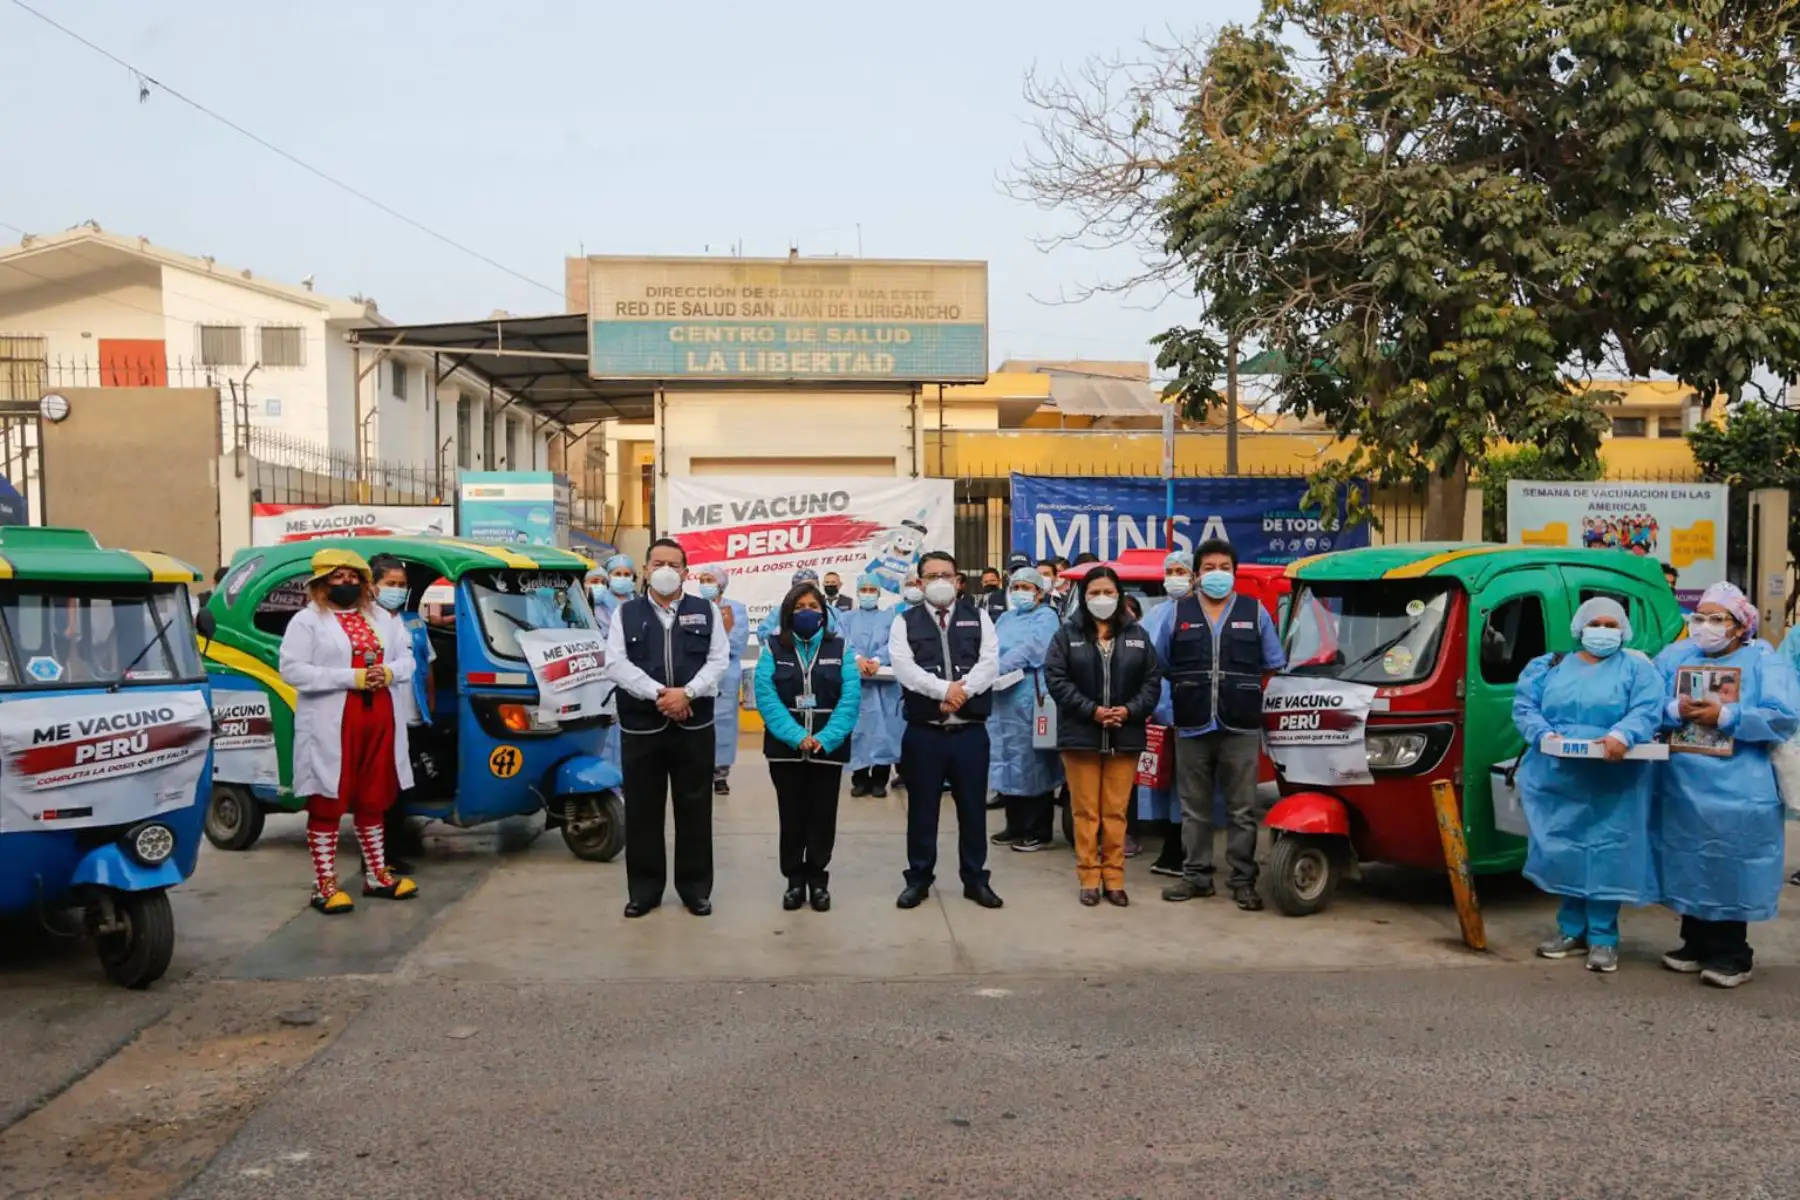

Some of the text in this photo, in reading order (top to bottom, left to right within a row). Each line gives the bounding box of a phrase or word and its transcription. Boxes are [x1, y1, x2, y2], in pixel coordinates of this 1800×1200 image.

[646, 285, 736, 298] DIRECCIÓN
[742, 287, 764, 298] DE
[769, 287, 824, 299] SALUD
[616, 301, 960, 319] RED DE SALUD SAN JUAN DE LURIGANCHO
[669, 326, 912, 344] CENTRO DE SALUD
[688, 350, 896, 372] LA LIBERTAD
[1522, 488, 1571, 498] SEMANA
[1573, 488, 1588, 498] DE
[1671, 489, 1687, 499] EN
[1689, 489, 1712, 500] LAS
[681, 490, 850, 528] ME VACUNO
[286, 513, 376, 533] ME VACUNO
[1263, 518, 1283, 532] DE
[726, 519, 811, 559] PERÚ
[1035, 513, 1231, 563] MINSA
[746, 564, 759, 574] LA
[762, 560, 793, 572] DOSIS
[796, 557, 819, 569] QUE
[821, 555, 832, 565] TE
[835, 553, 868, 564] FALTA
[543, 645, 563, 661] ME
[1264, 694, 1344, 709] ME VACUNO
[33, 708, 174, 745] ME VACUNO
[1279, 710, 1321, 730] PERÚ
[75, 730, 149, 764] PERÚ
[37, 769, 90, 786] COMPLETA
[92, 767, 106, 775] LA
[108, 762, 136, 773] DOSIS
[137, 757, 155, 767] QUE
[156, 754, 166, 762] TE
